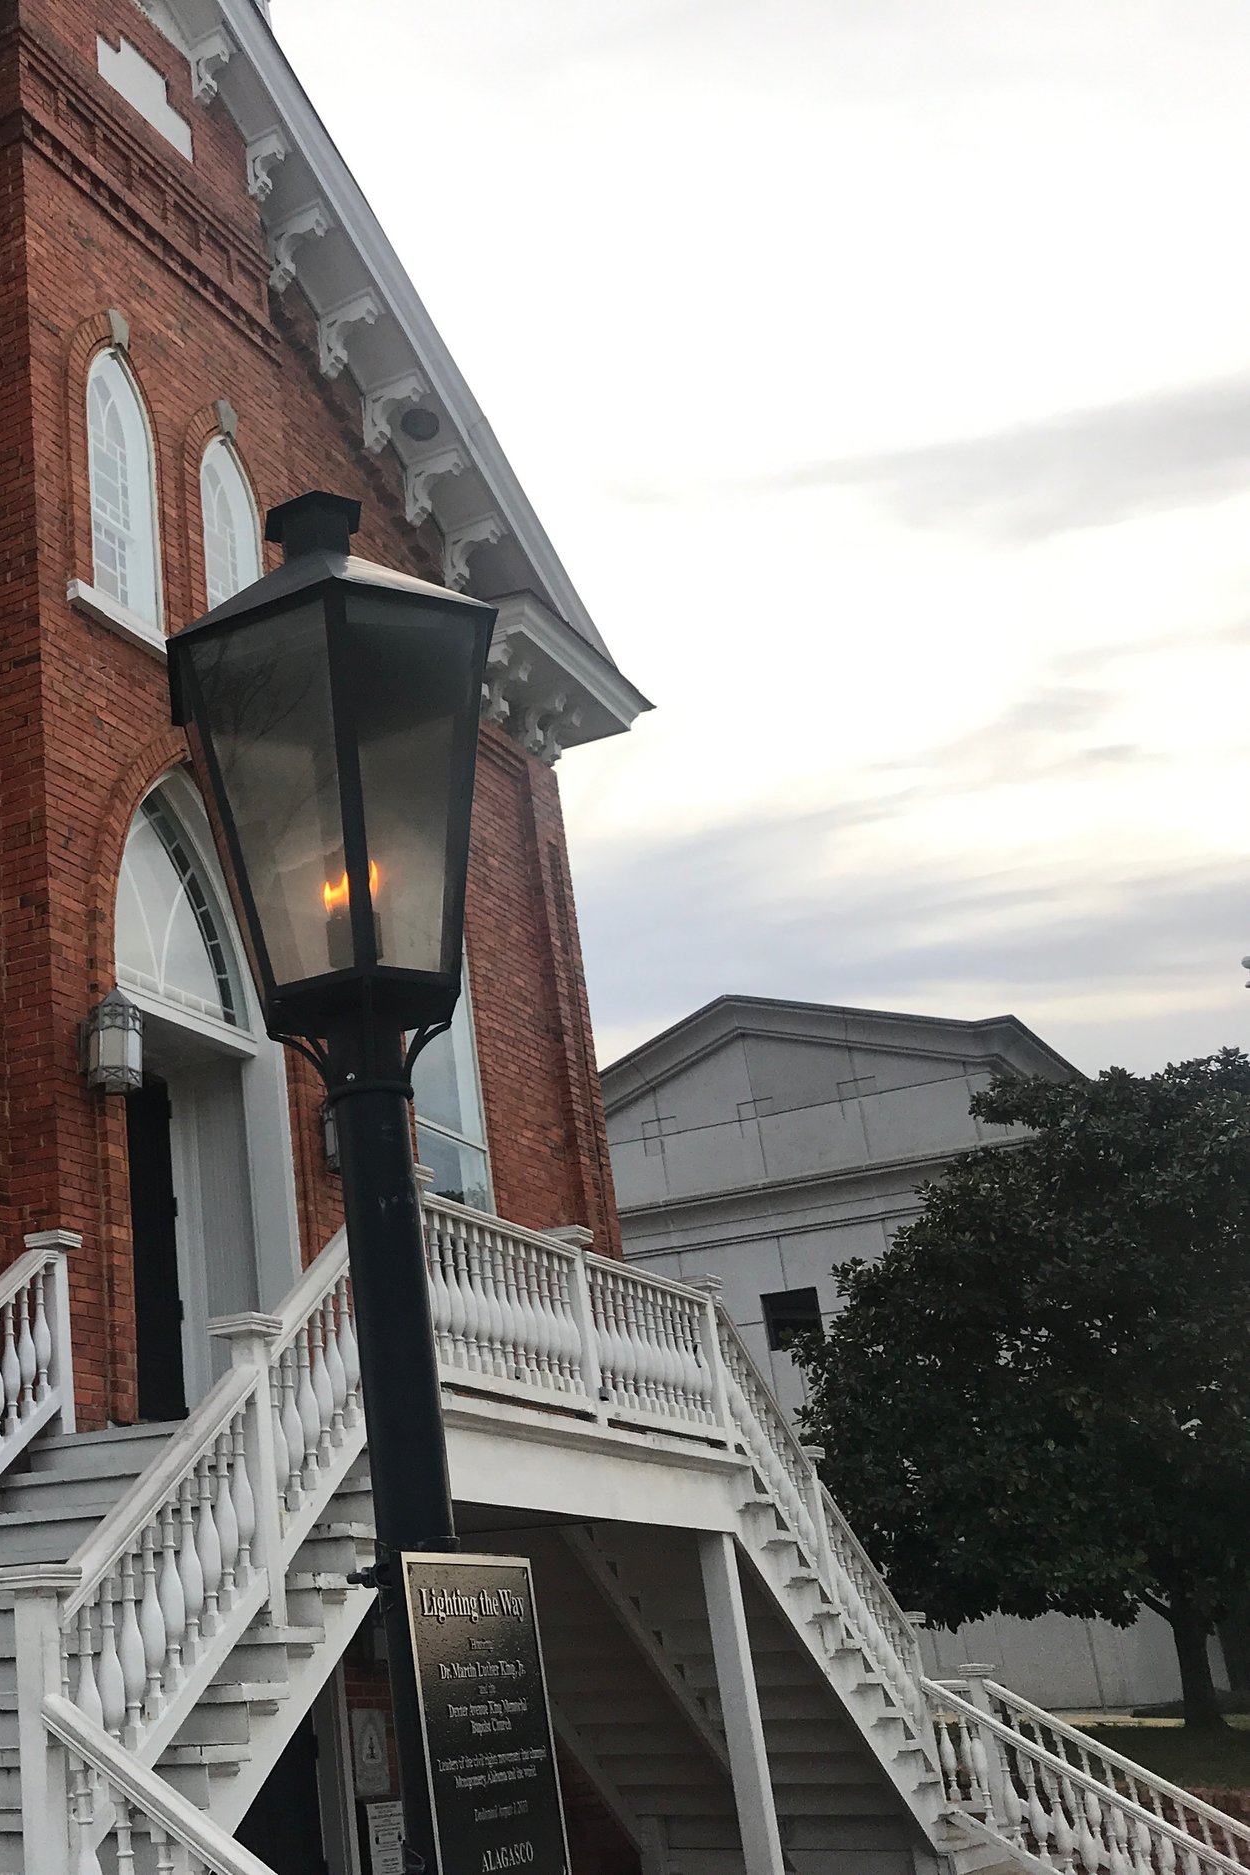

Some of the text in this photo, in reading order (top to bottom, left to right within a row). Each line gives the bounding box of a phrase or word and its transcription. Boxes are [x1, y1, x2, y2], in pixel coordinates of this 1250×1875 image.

[419, 1587, 524, 1623] Lighting the Way
[439, 1663, 452, 1680] Dr.
[451, 1662, 477, 1679] Martin
[476, 1661, 499, 1677] Luther
[482, 1841, 534, 1873] ALAGASCO
